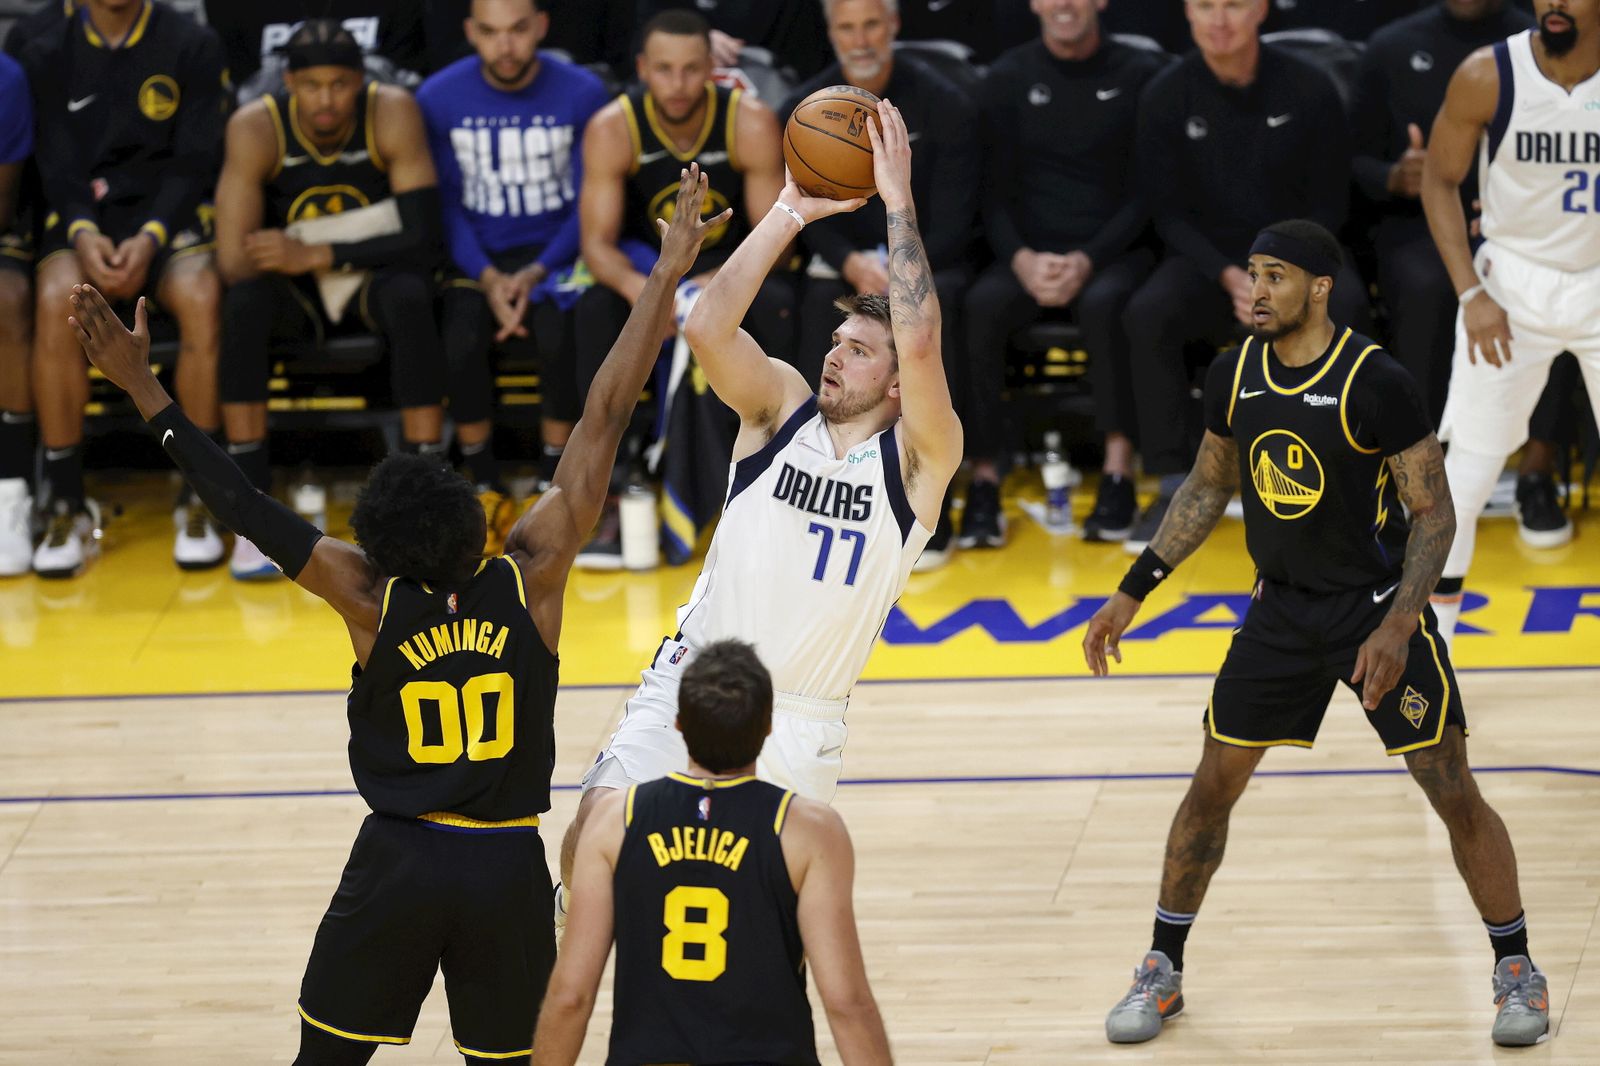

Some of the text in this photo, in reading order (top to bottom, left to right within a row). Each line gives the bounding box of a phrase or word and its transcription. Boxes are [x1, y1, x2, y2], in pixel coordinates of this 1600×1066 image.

[1516, 131, 1600, 163] DALLA
[1562, 169, 1600, 214] 2
[1303, 393, 1338, 405] Rakuten
[1287, 443, 1304, 470] 0
[772, 462, 873, 522] DALLAS
[807, 521, 867, 587] 77
[398, 618, 510, 671] KUMINGA
[400, 672, 514, 763] 00
[647, 826, 750, 872] BJELICA
[661, 885, 730, 982] 8
